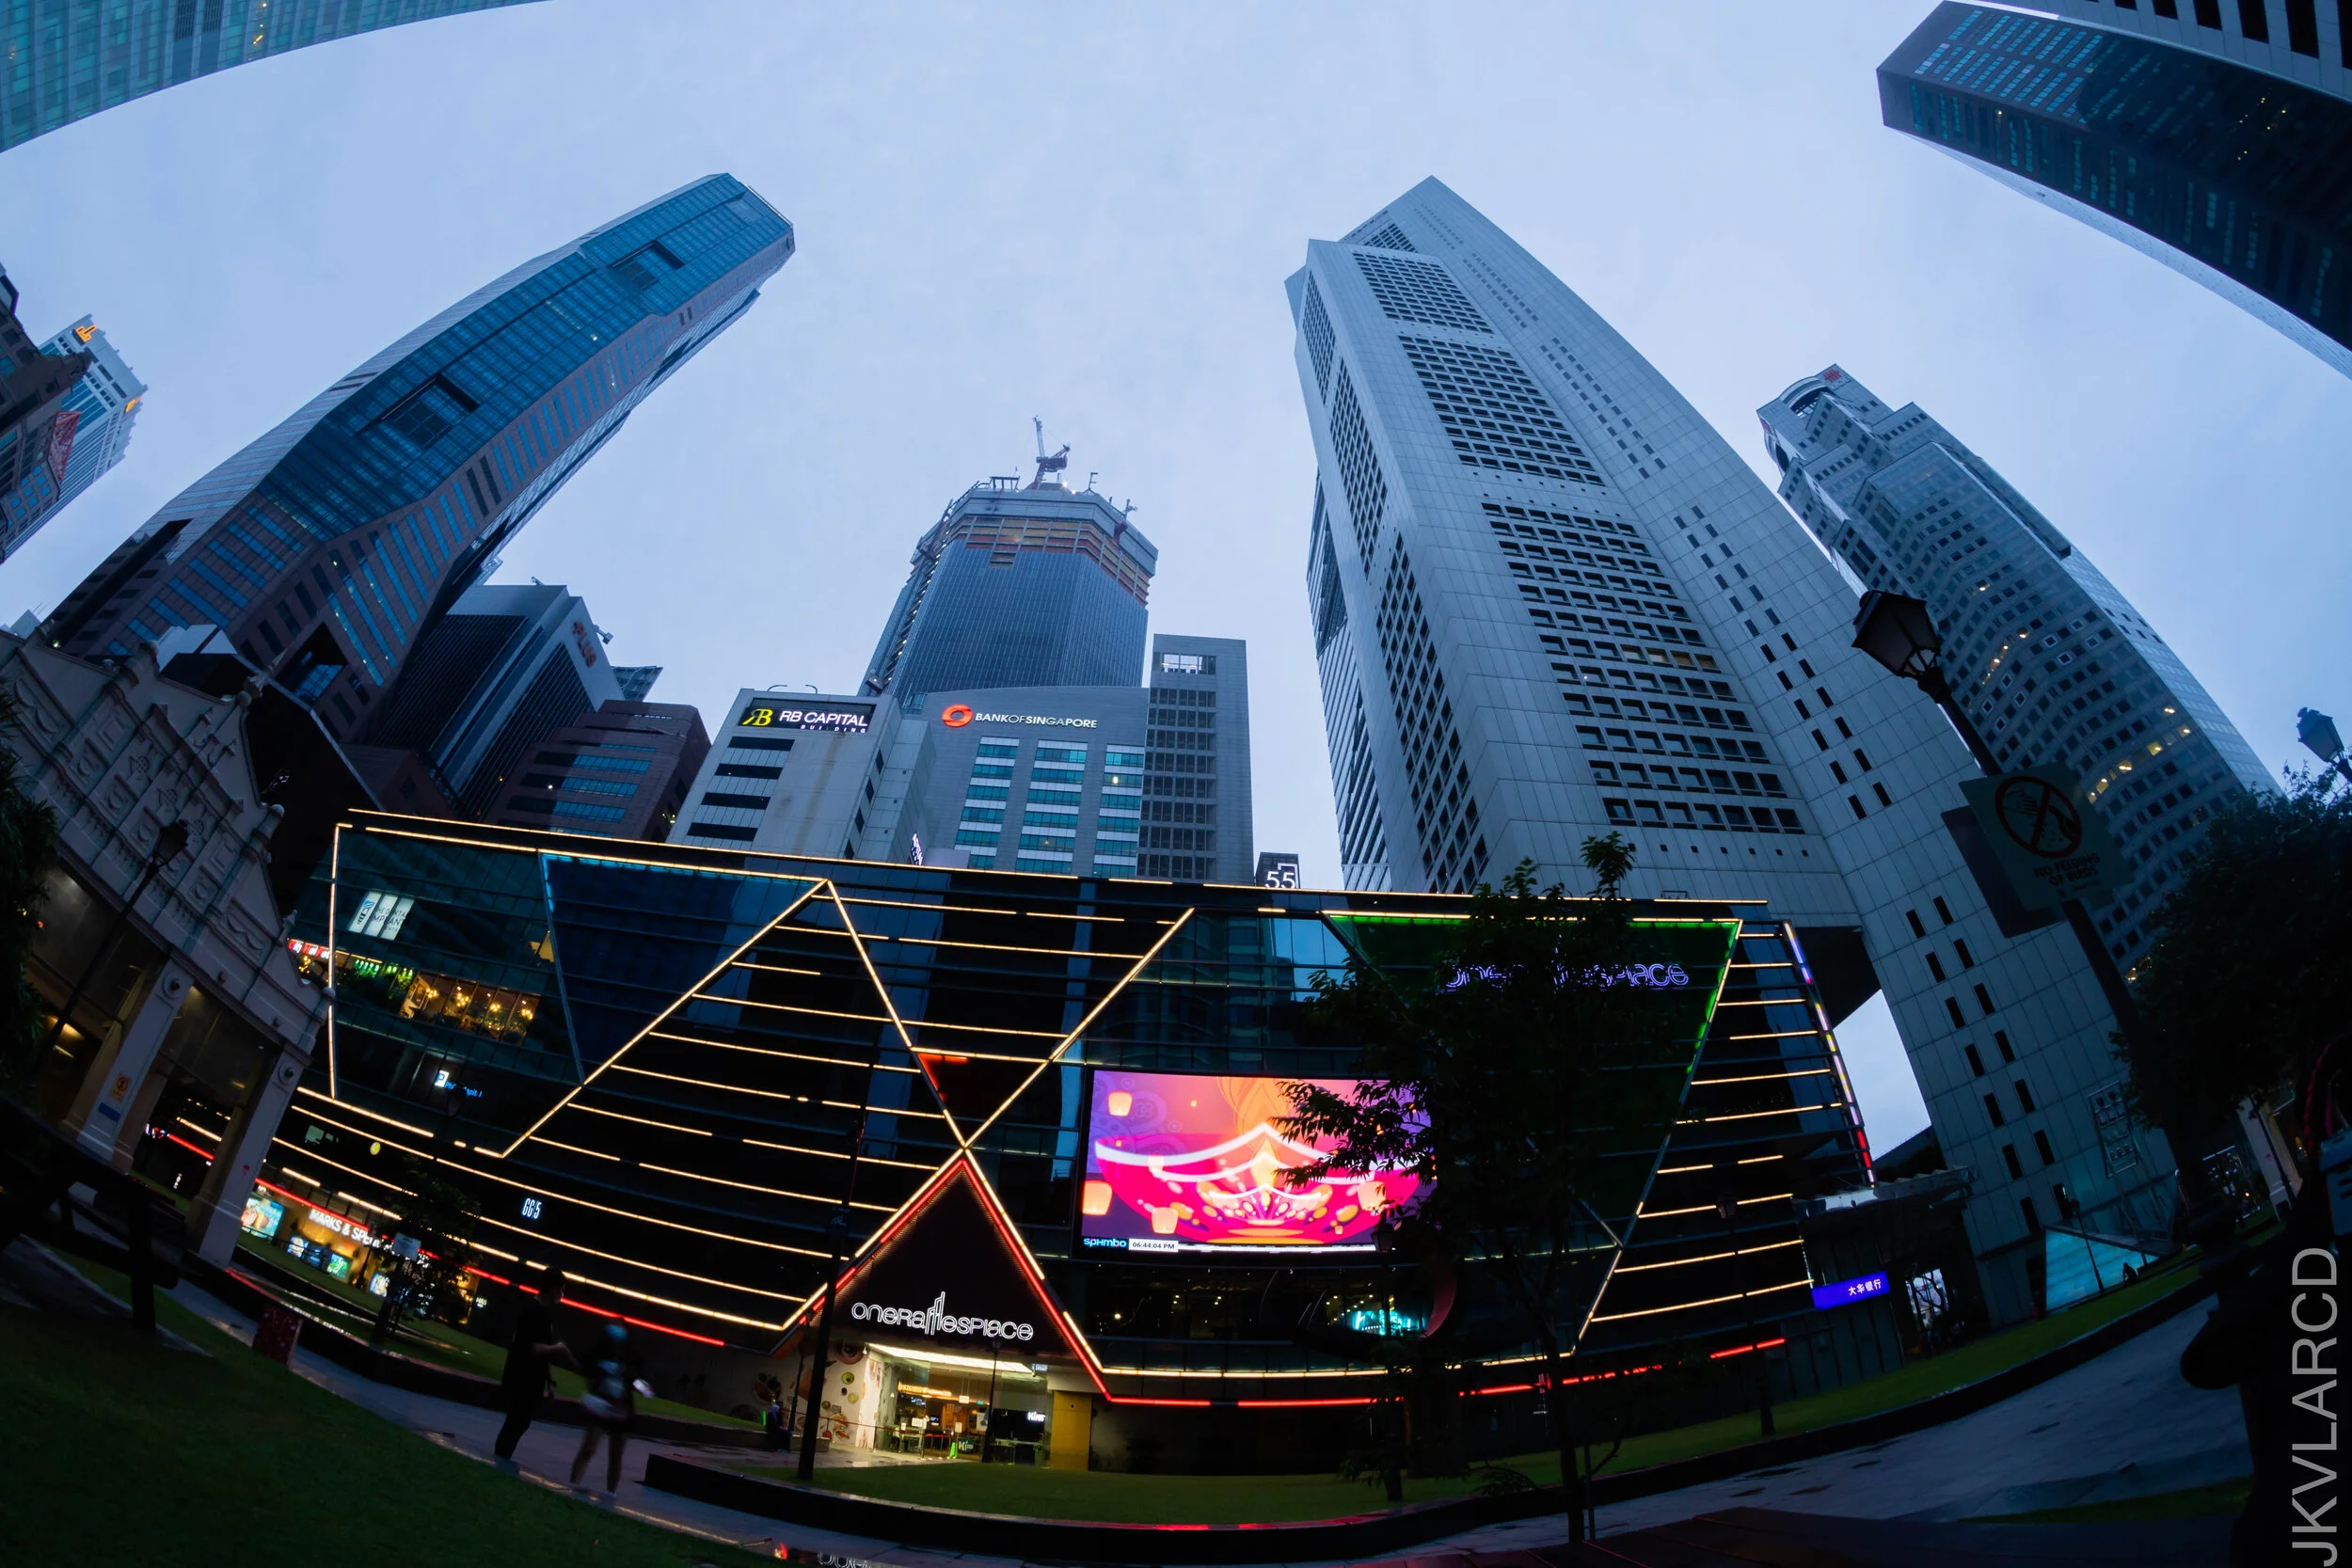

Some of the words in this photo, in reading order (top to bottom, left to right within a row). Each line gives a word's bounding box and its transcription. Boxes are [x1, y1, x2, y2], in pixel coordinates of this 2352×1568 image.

[779, 710, 803, 722] RB
[804, 712, 868, 726] CAPITAL
[801, 724, 866, 734] BUIDING
[1264, 870, 1296, 889] 55
[309, 1208, 342, 1233] MARKS
[342, 1220, 351, 1237] &
[1848, 1278, 1882, 1296] 大华银行
